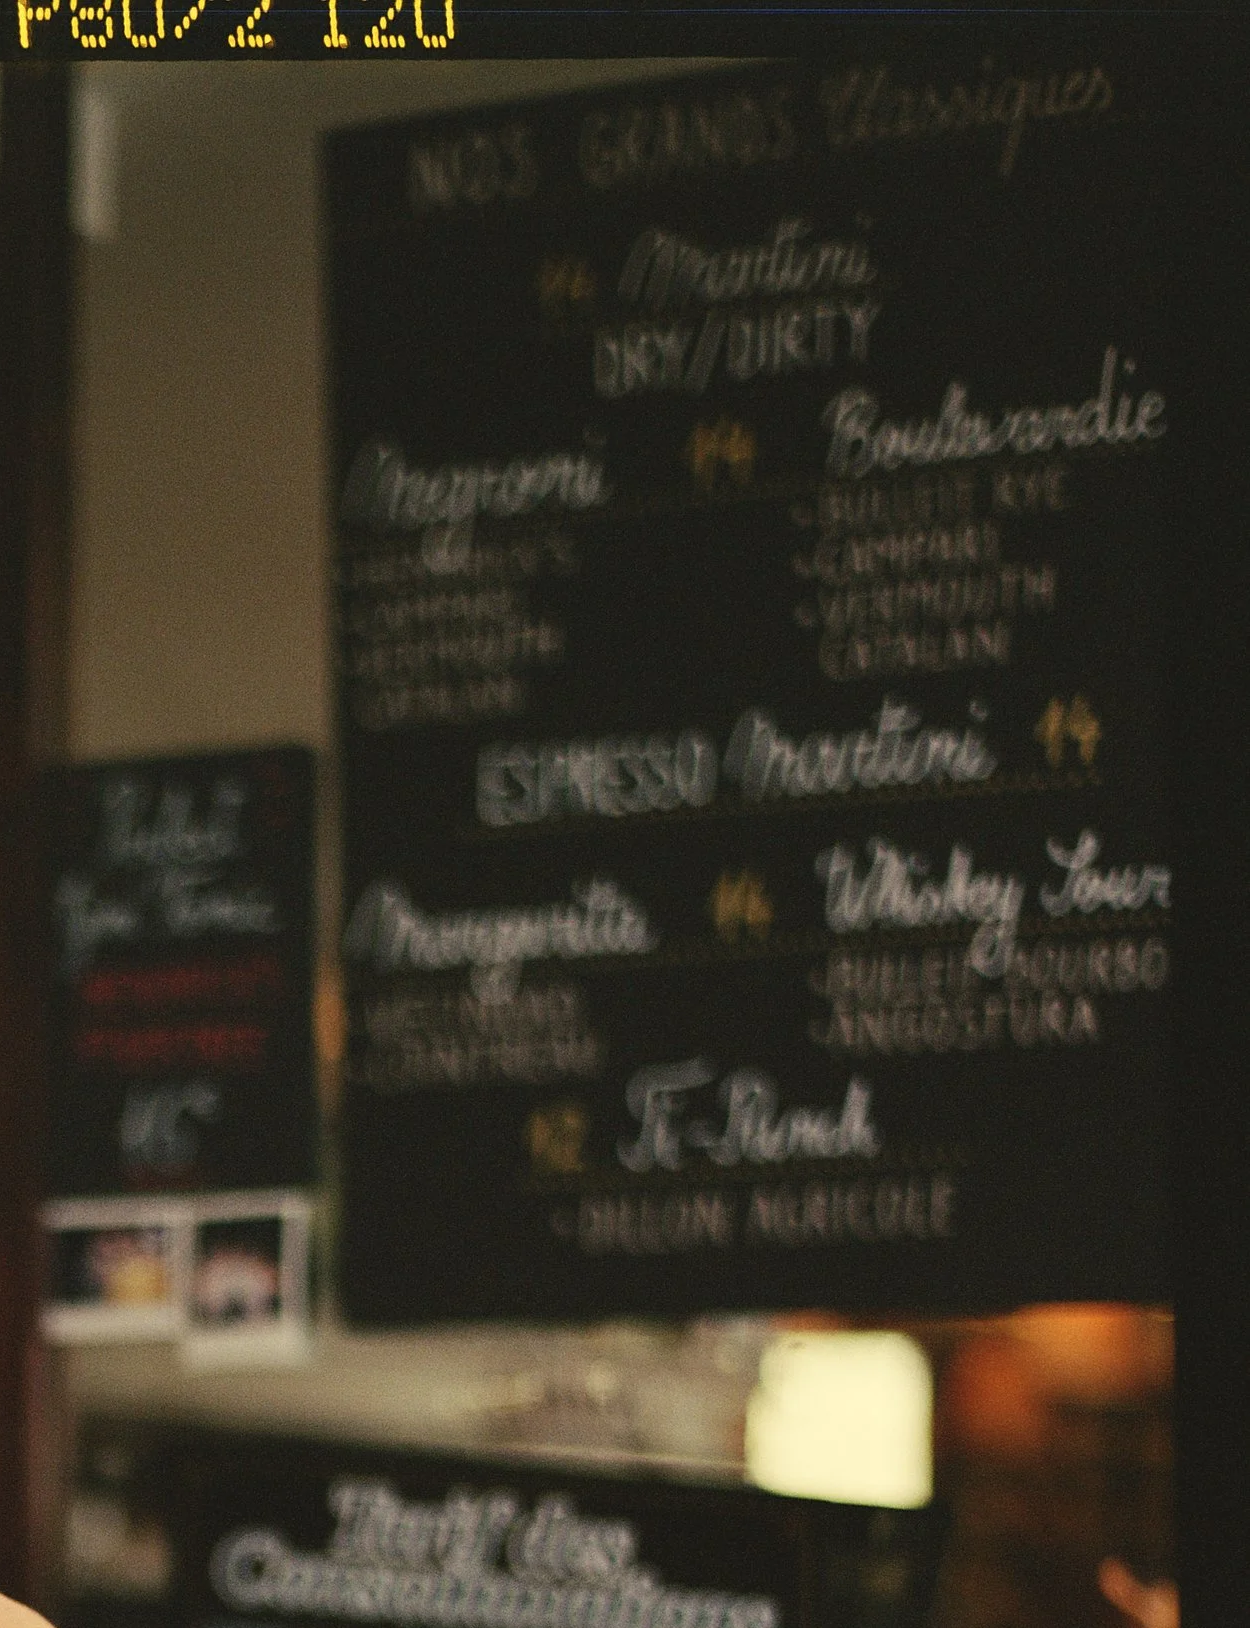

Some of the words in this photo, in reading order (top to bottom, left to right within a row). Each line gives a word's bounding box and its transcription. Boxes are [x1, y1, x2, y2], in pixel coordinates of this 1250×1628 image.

[616, 214, 881, 309] Martini
[592, 298, 881, 399] DRY/DIRTY
[475, 730, 718, 827] ESPRESSO
[723, 696, 998, 800] Martini
